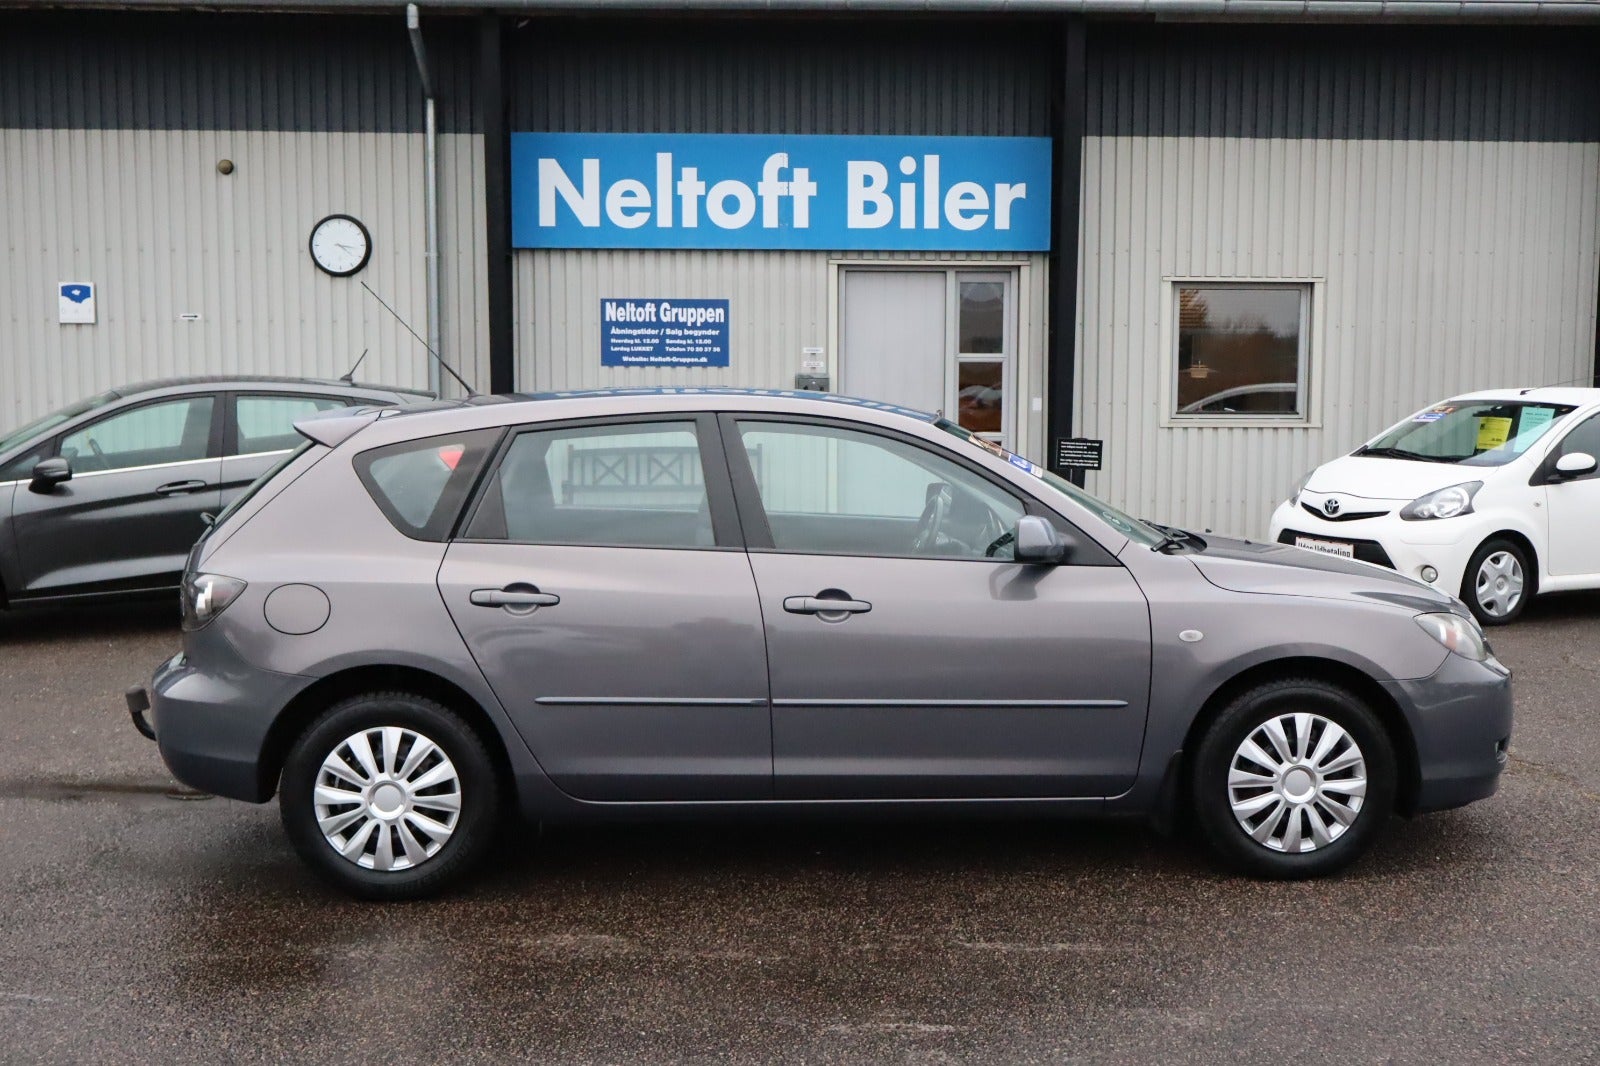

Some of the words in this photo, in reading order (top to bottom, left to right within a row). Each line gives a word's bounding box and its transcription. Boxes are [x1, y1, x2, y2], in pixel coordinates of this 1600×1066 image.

[538, 152, 817, 229] Neltoft
[846, 154, 1026, 231] Biler
[605, 302, 656, 322] Neltoft
[660, 302, 724, 326] Gruppen
[610, 326, 659, 336] Åbningstider
[666, 328, 682, 336] Salg
[684, 328, 720, 336] begynder
